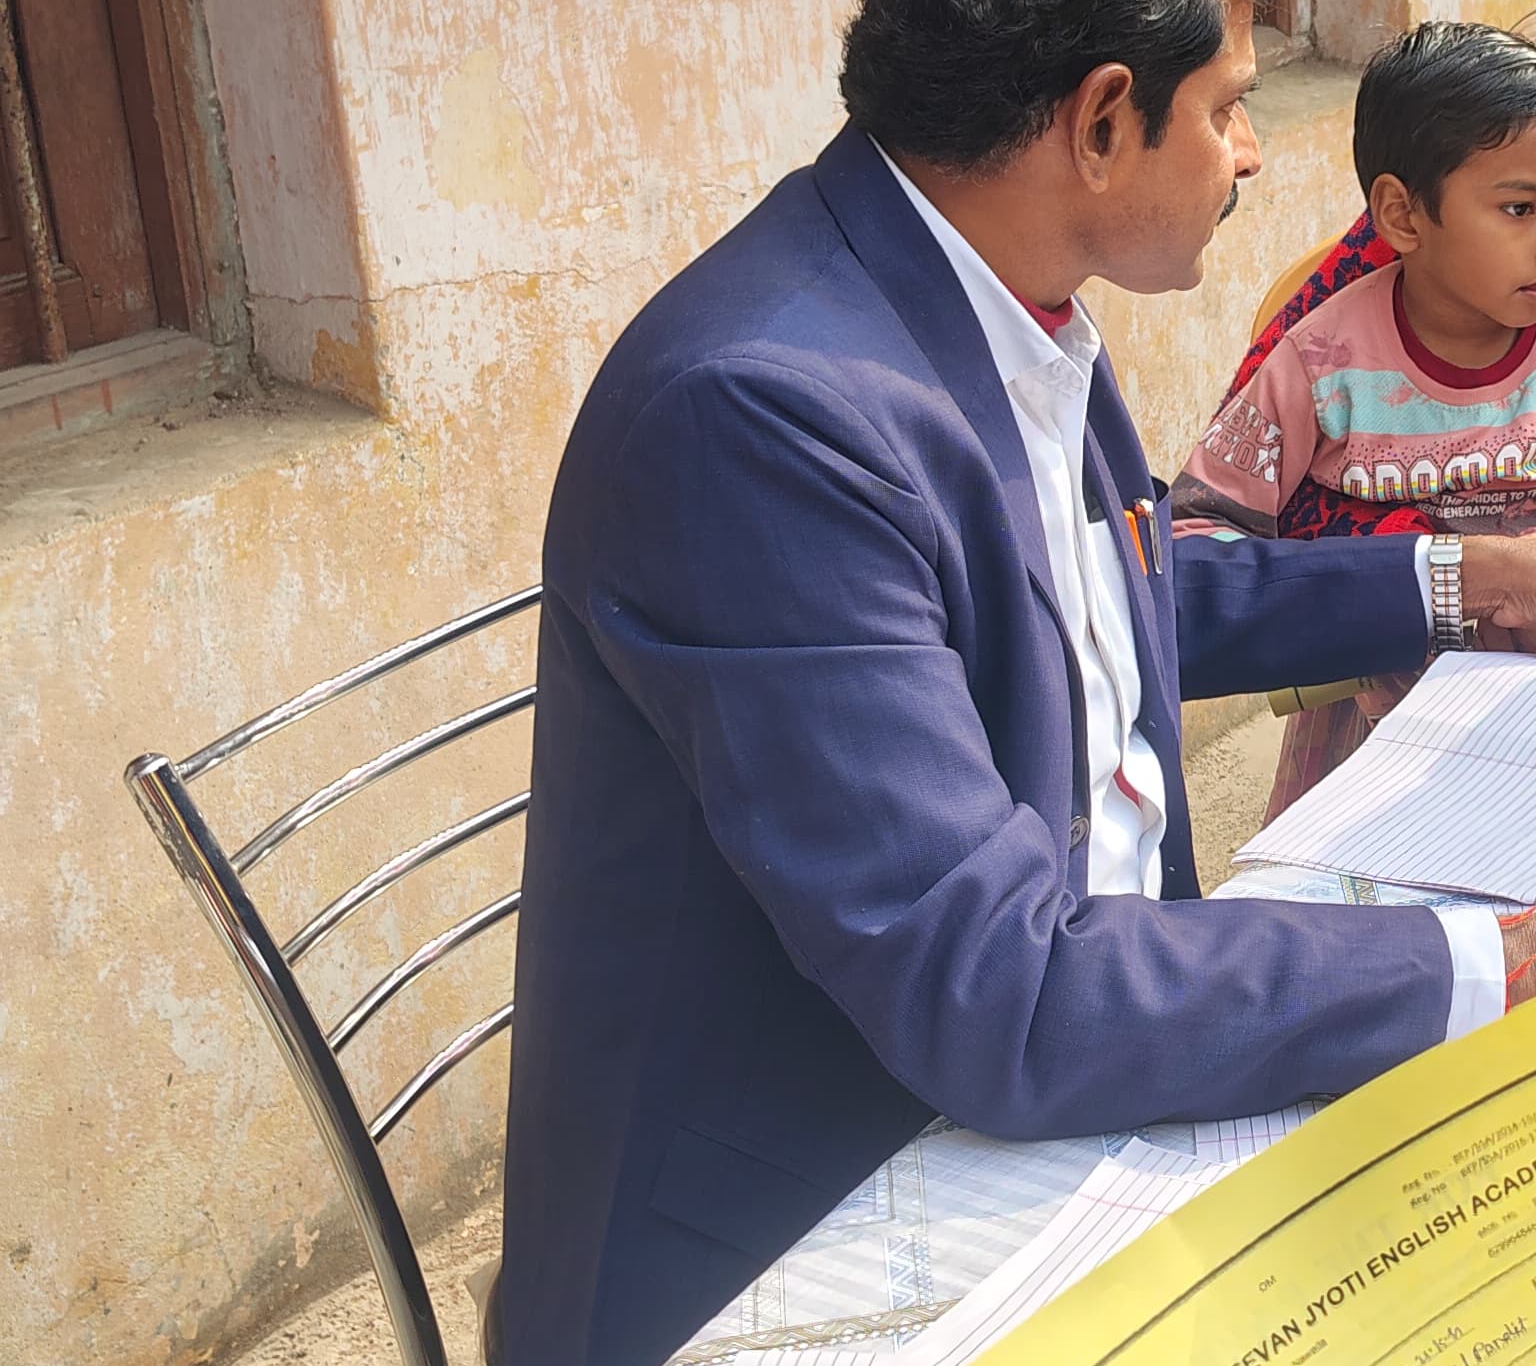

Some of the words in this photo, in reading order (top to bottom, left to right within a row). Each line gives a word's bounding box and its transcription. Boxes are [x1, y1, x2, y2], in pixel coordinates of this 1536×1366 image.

[1510, 492, 1525, 501] TO
[1298, 1268, 1367, 1328] JYOTI
[1363, 1203, 1468, 1280] ENGLISH
[1256, 1273, 1278, 1294] OM
